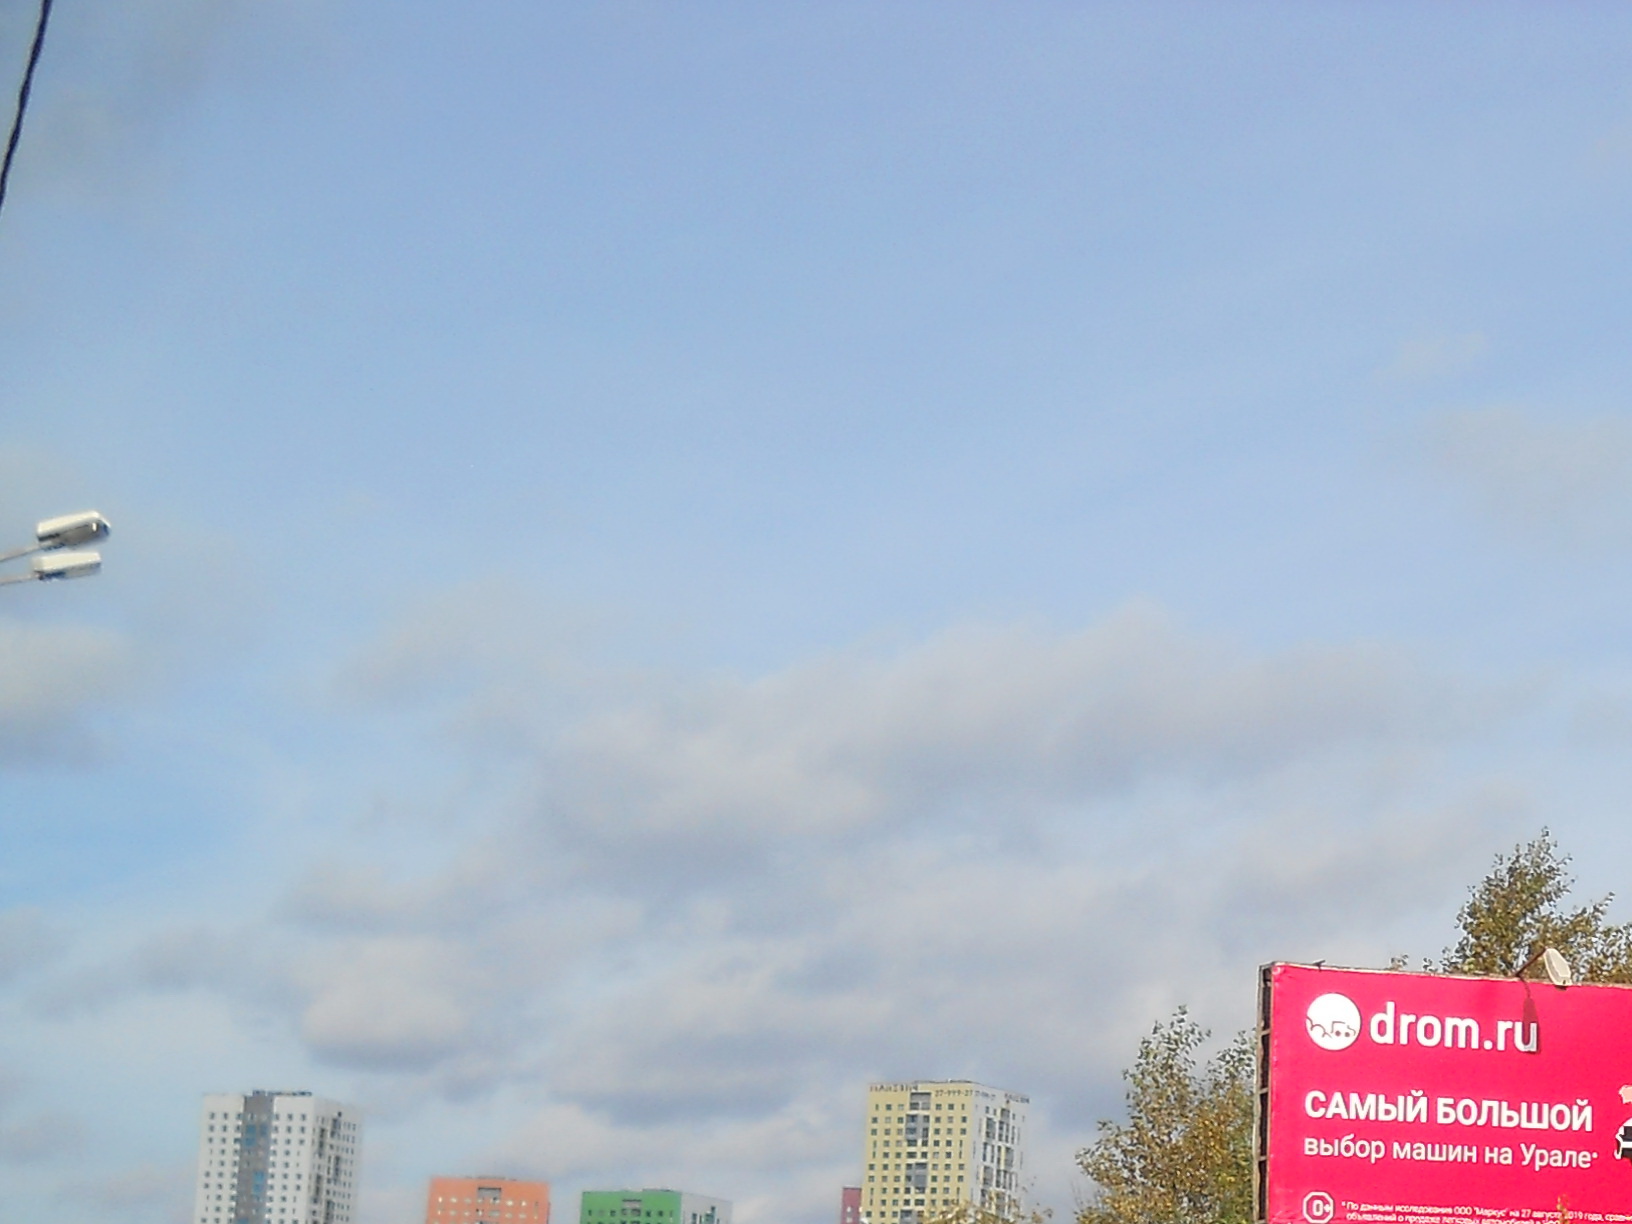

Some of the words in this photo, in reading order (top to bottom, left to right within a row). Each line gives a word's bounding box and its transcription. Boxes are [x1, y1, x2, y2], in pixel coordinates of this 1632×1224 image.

[1369, 1001, 1538, 1052] drom.ru
[1304, 1090, 1428, 1123] САМЫЙ
[1436, 1098, 1593, 1132] БОЛЬШОЙ
[1304, 1134, 1386, 1163] выбор
[1392, 1141, 1477, 1163] машин
[1484, 1145, 1513, 1165] на
[1360, 1203, 1394, 1212] данным
[1453, 1206, 1473, 1215] ООО
[1521, 1208, 1532, 1218] 27
